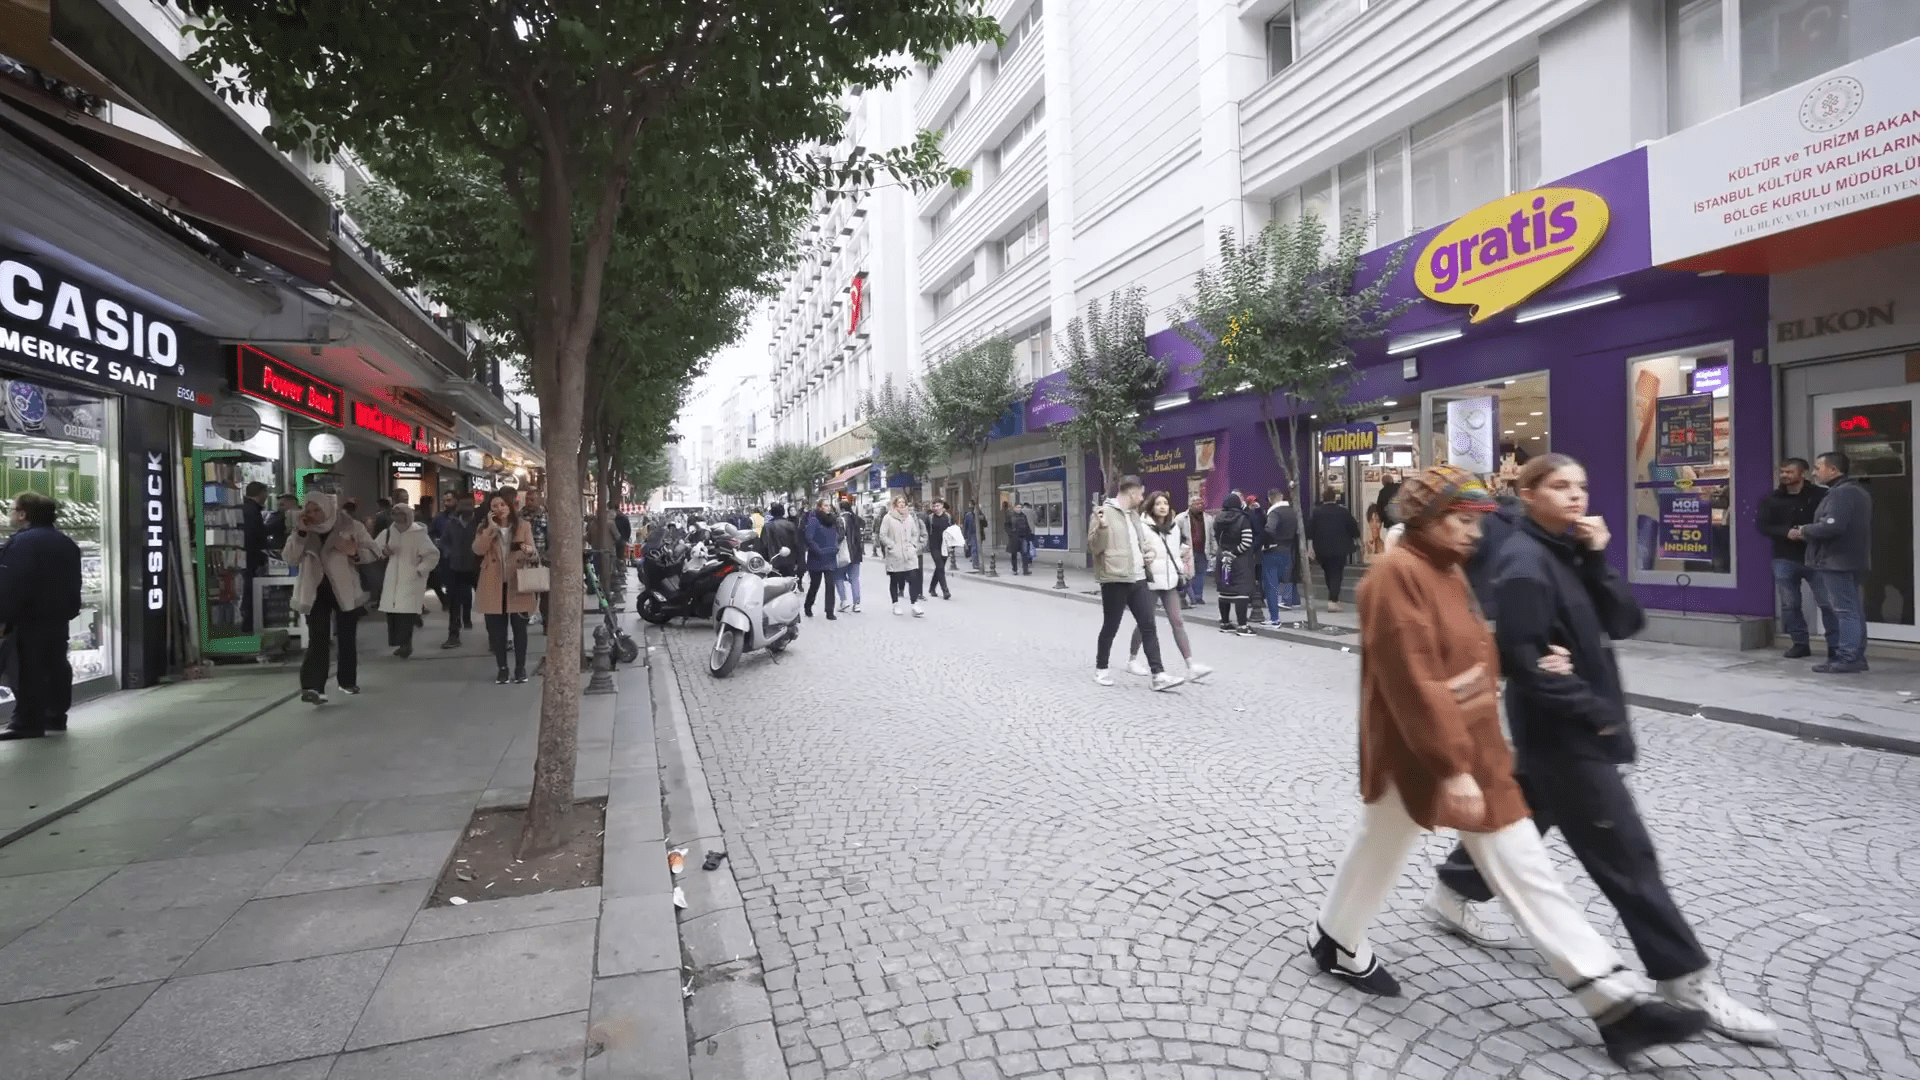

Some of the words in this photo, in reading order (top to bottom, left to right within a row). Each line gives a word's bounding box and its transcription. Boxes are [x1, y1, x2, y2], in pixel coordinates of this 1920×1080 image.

[1694, 187, 1754, 214] İSTANBUL
[1758, 166, 1813, 194] KÜLTÜR
[1816, 133, 1920, 175] VARLIKLARIN
[1724, 202, 1768, 224] BÖLGE
[1772, 183, 1831, 210] KURULU
[1835, 155, 1920, 192] MÜDÜRLÜ
[1728, 156, 1780, 183] KÜLTÜR
[1784, 152, 1799, 164] ve
[1803, 129, 1859, 157] TURİZM
[1431, 196, 1577, 293] gratis
[0, 260, 177, 367] CASIO
[1777, 302, 1896, 344] ELKON
[0, 327, 99, 375] MERKEZ
[107, 361, 157, 391] SAAT
[64, 423, 100, 440] ORIENT
[148, 451, 163, 610] G-SHOCK
